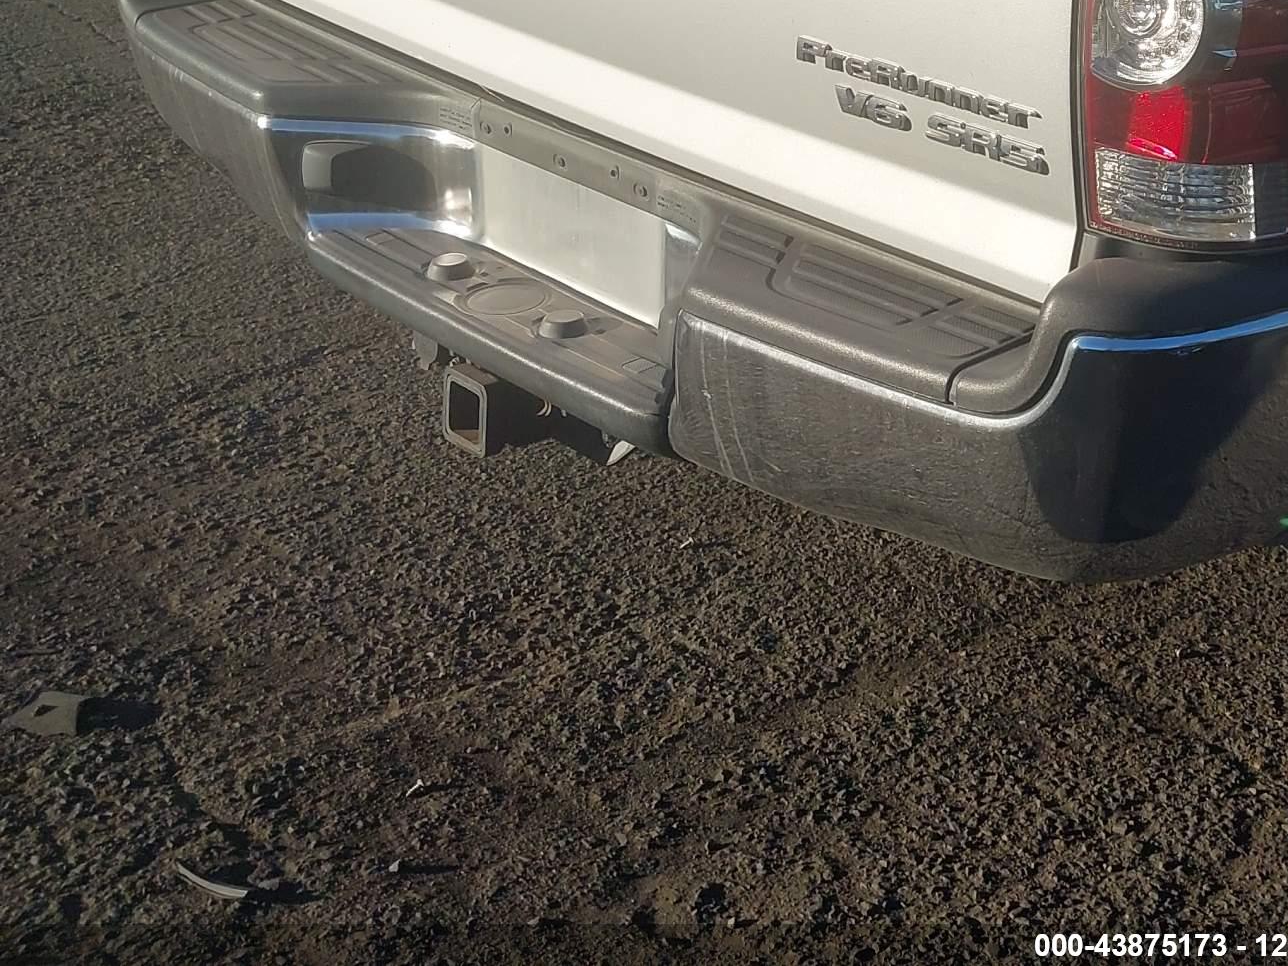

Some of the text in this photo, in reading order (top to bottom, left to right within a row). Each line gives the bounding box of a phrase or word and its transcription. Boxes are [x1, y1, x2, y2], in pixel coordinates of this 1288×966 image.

[796, 34, 1043, 129] PreRunner
[834, 84, 1051, 176] V6 SR5
